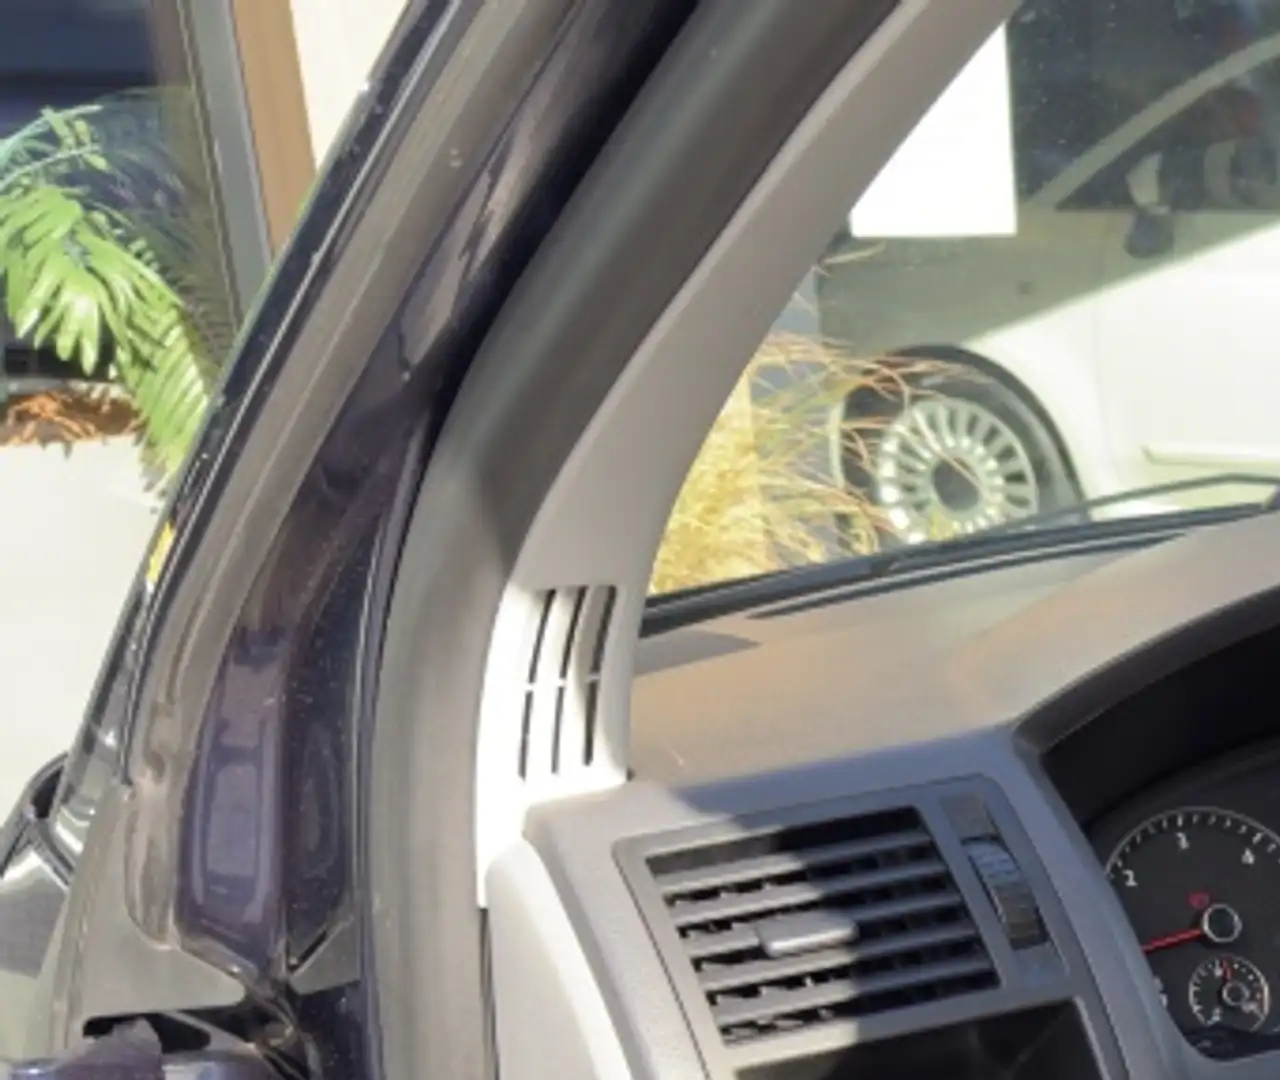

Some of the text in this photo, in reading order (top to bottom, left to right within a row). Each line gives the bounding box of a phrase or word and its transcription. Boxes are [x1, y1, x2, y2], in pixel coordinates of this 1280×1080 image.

[1176, 832, 1189, 850] 3
[1241, 848, 1255, 865] 4
[1122, 869, 1137, 887] 2
